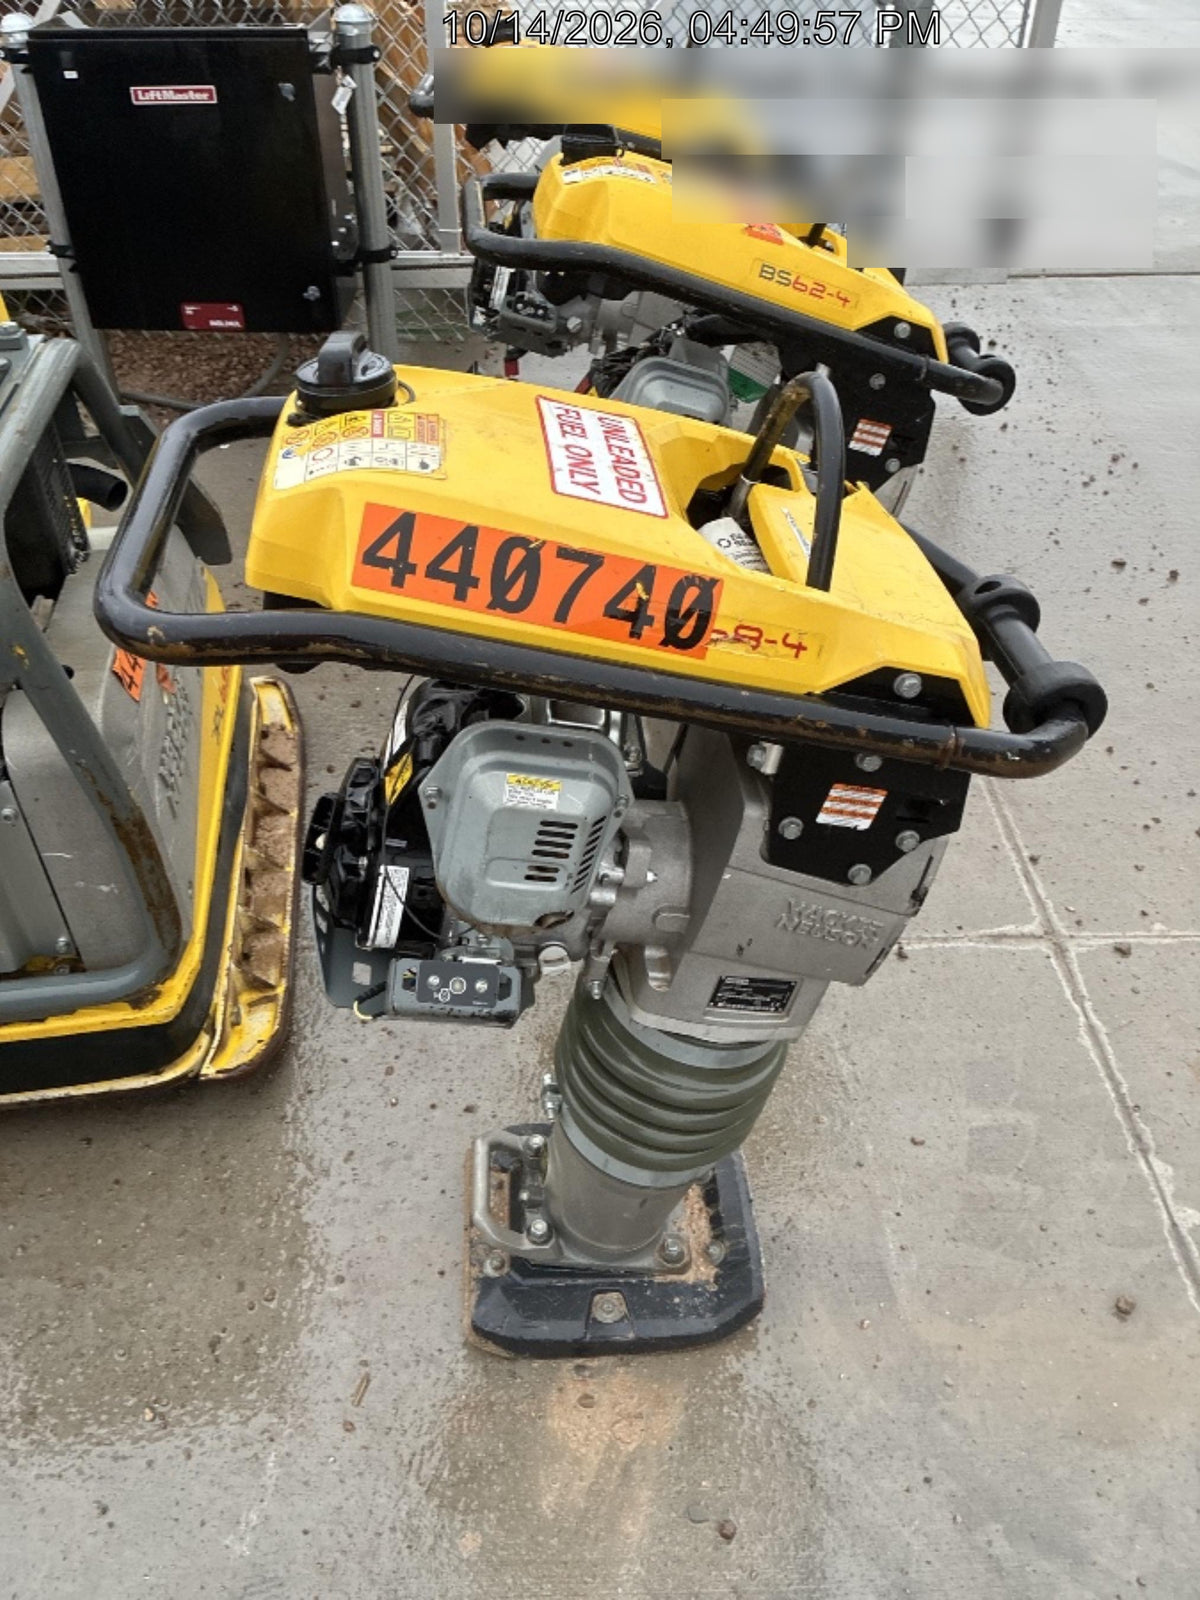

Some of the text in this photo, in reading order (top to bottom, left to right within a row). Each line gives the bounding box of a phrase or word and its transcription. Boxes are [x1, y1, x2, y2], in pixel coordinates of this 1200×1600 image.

[136, 90, 210, 101] LiftMaster
[759, 263, 851, 308] BS62-4
[555, 406, 602, 495] FUEL ONLY
[597, 416, 648, 504] UNLEADED
